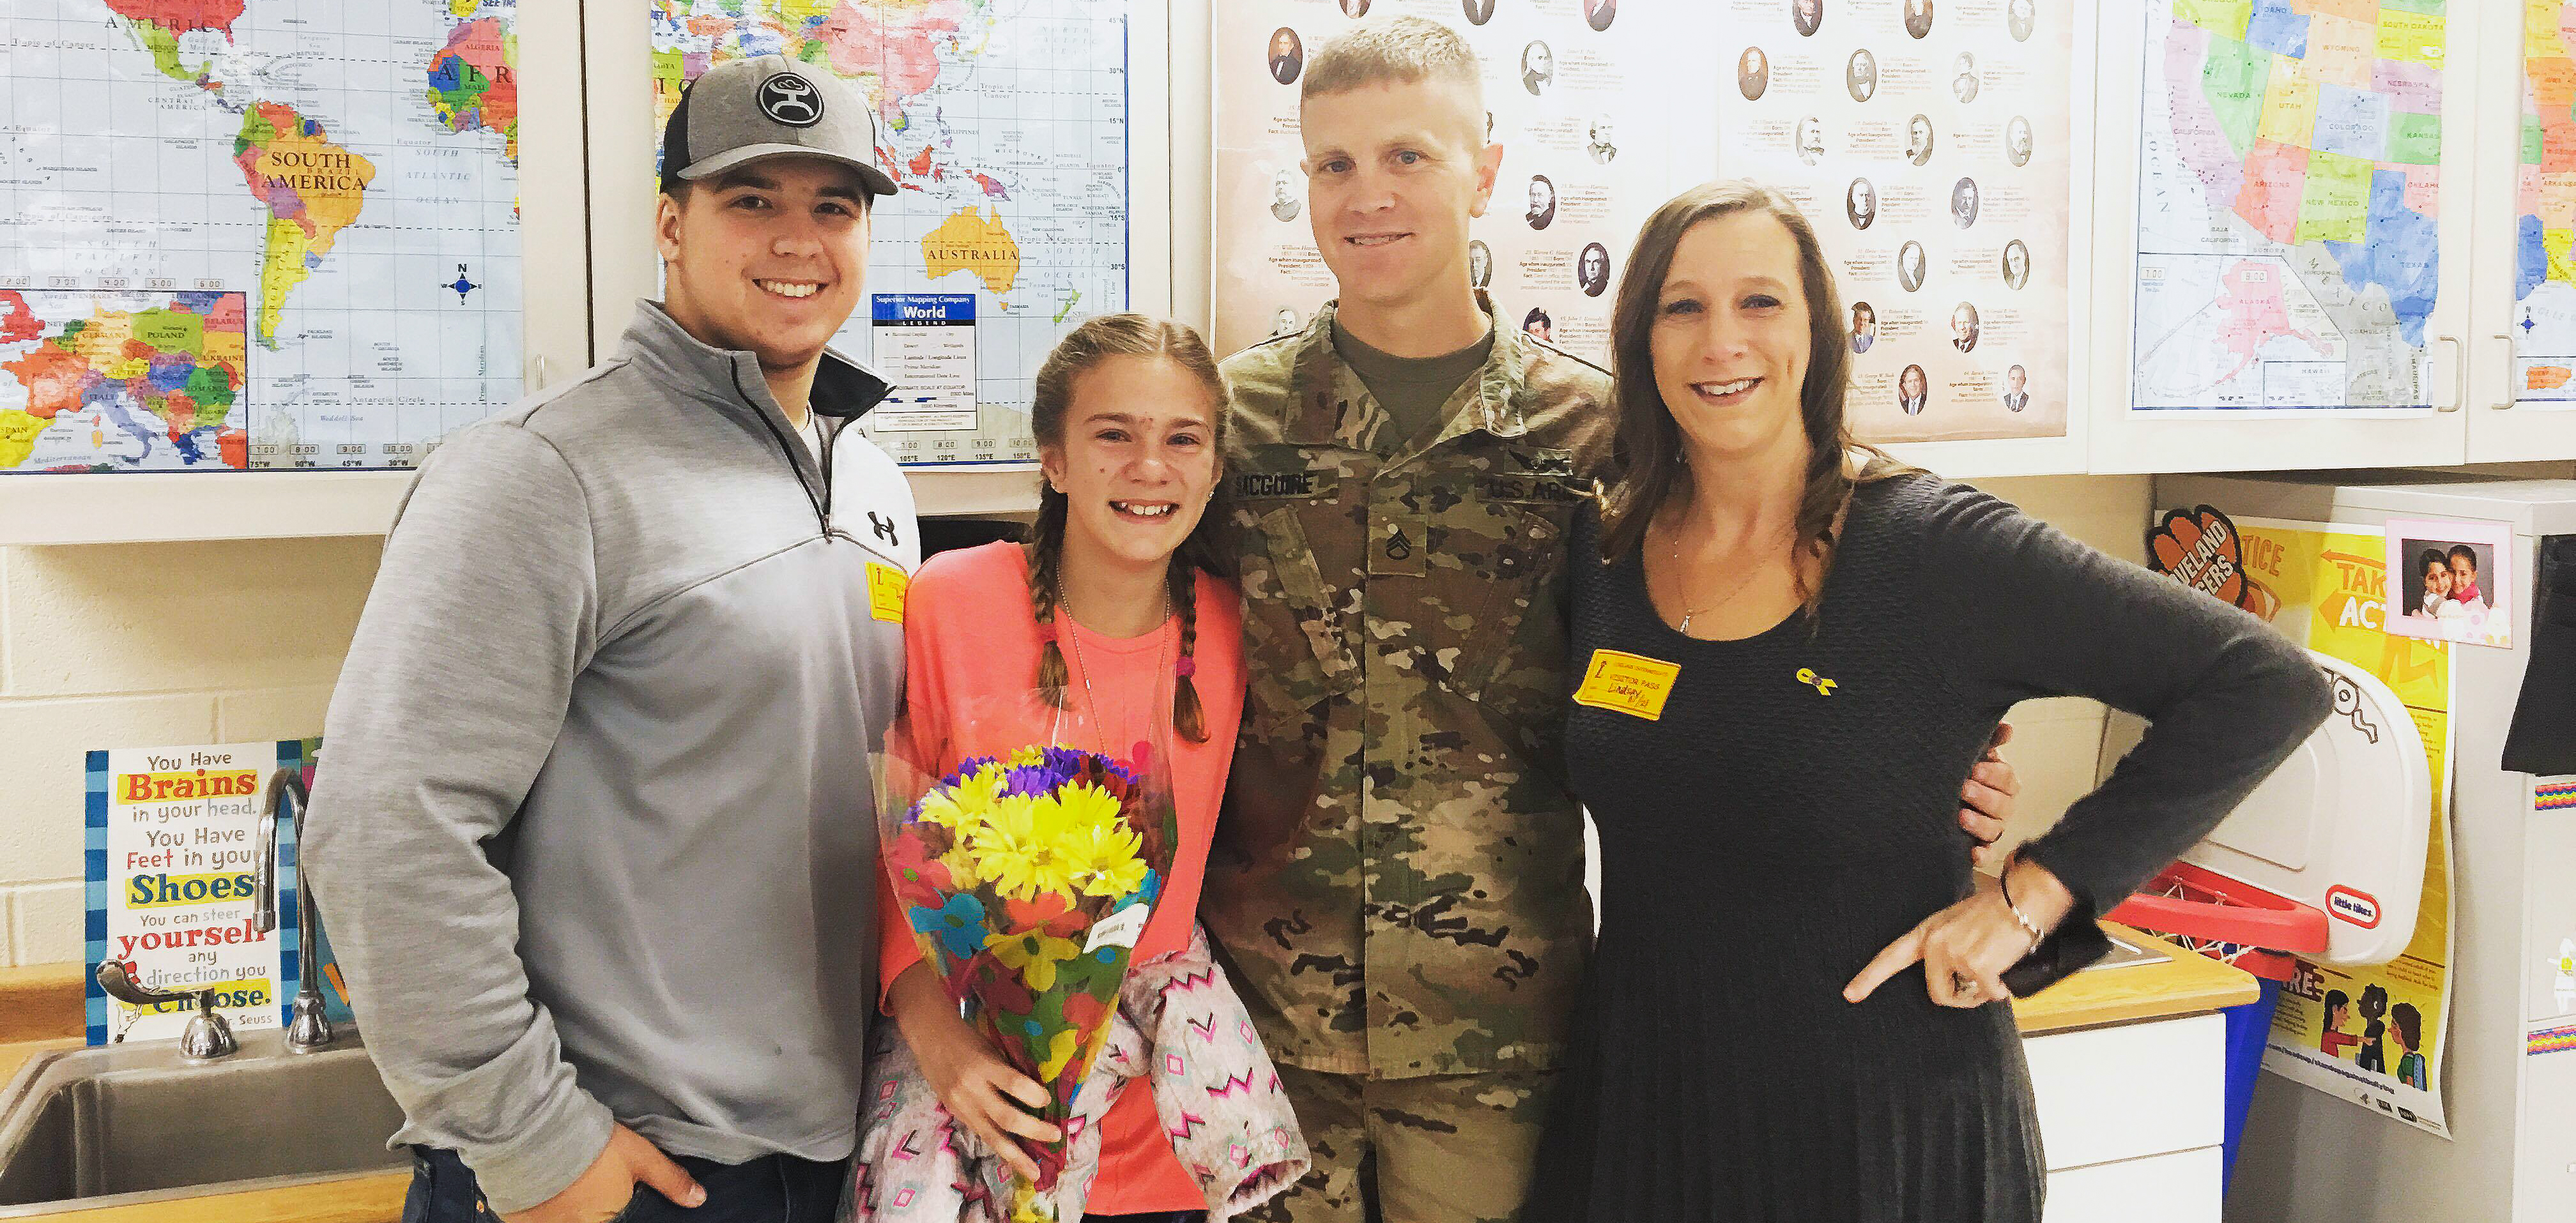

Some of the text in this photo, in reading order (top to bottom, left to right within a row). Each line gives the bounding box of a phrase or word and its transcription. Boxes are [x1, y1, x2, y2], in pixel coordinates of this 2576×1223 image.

[2412, 22, 2444, 31] DAKOTA
[2216, 91, 2251, 99] NEVADA
[2329, 123, 2374, 132] COLORADO
[272, 151, 351, 169] SOUTH
[415, 149, 459, 157] SOUTH
[262, 174, 367, 191] AMERICA
[406, 171, 471, 181] ATLANTIC
[2306, 199, 2359, 208] NEW MEXICO
[927, 249, 1018, 261] AUSTRALIA
[458, 263, 467, 273] N
[877, 295, 970, 305] Superior Mapping Company
[903, 305, 946, 319] World
[147, 752, 232, 771] You Have
[125, 768, 257, 801] Brains
[132, 798, 257, 824] in your head.
[145, 827, 245, 848] You Have
[126, 849, 259, 870] Feet in you
[130, 872, 256, 904] Shoes
[139, 908, 241, 927] You can steer
[188, 950, 217, 966] any
[146, 965, 266, 986] direction you
[239, 1014, 273, 1025] Seuss
